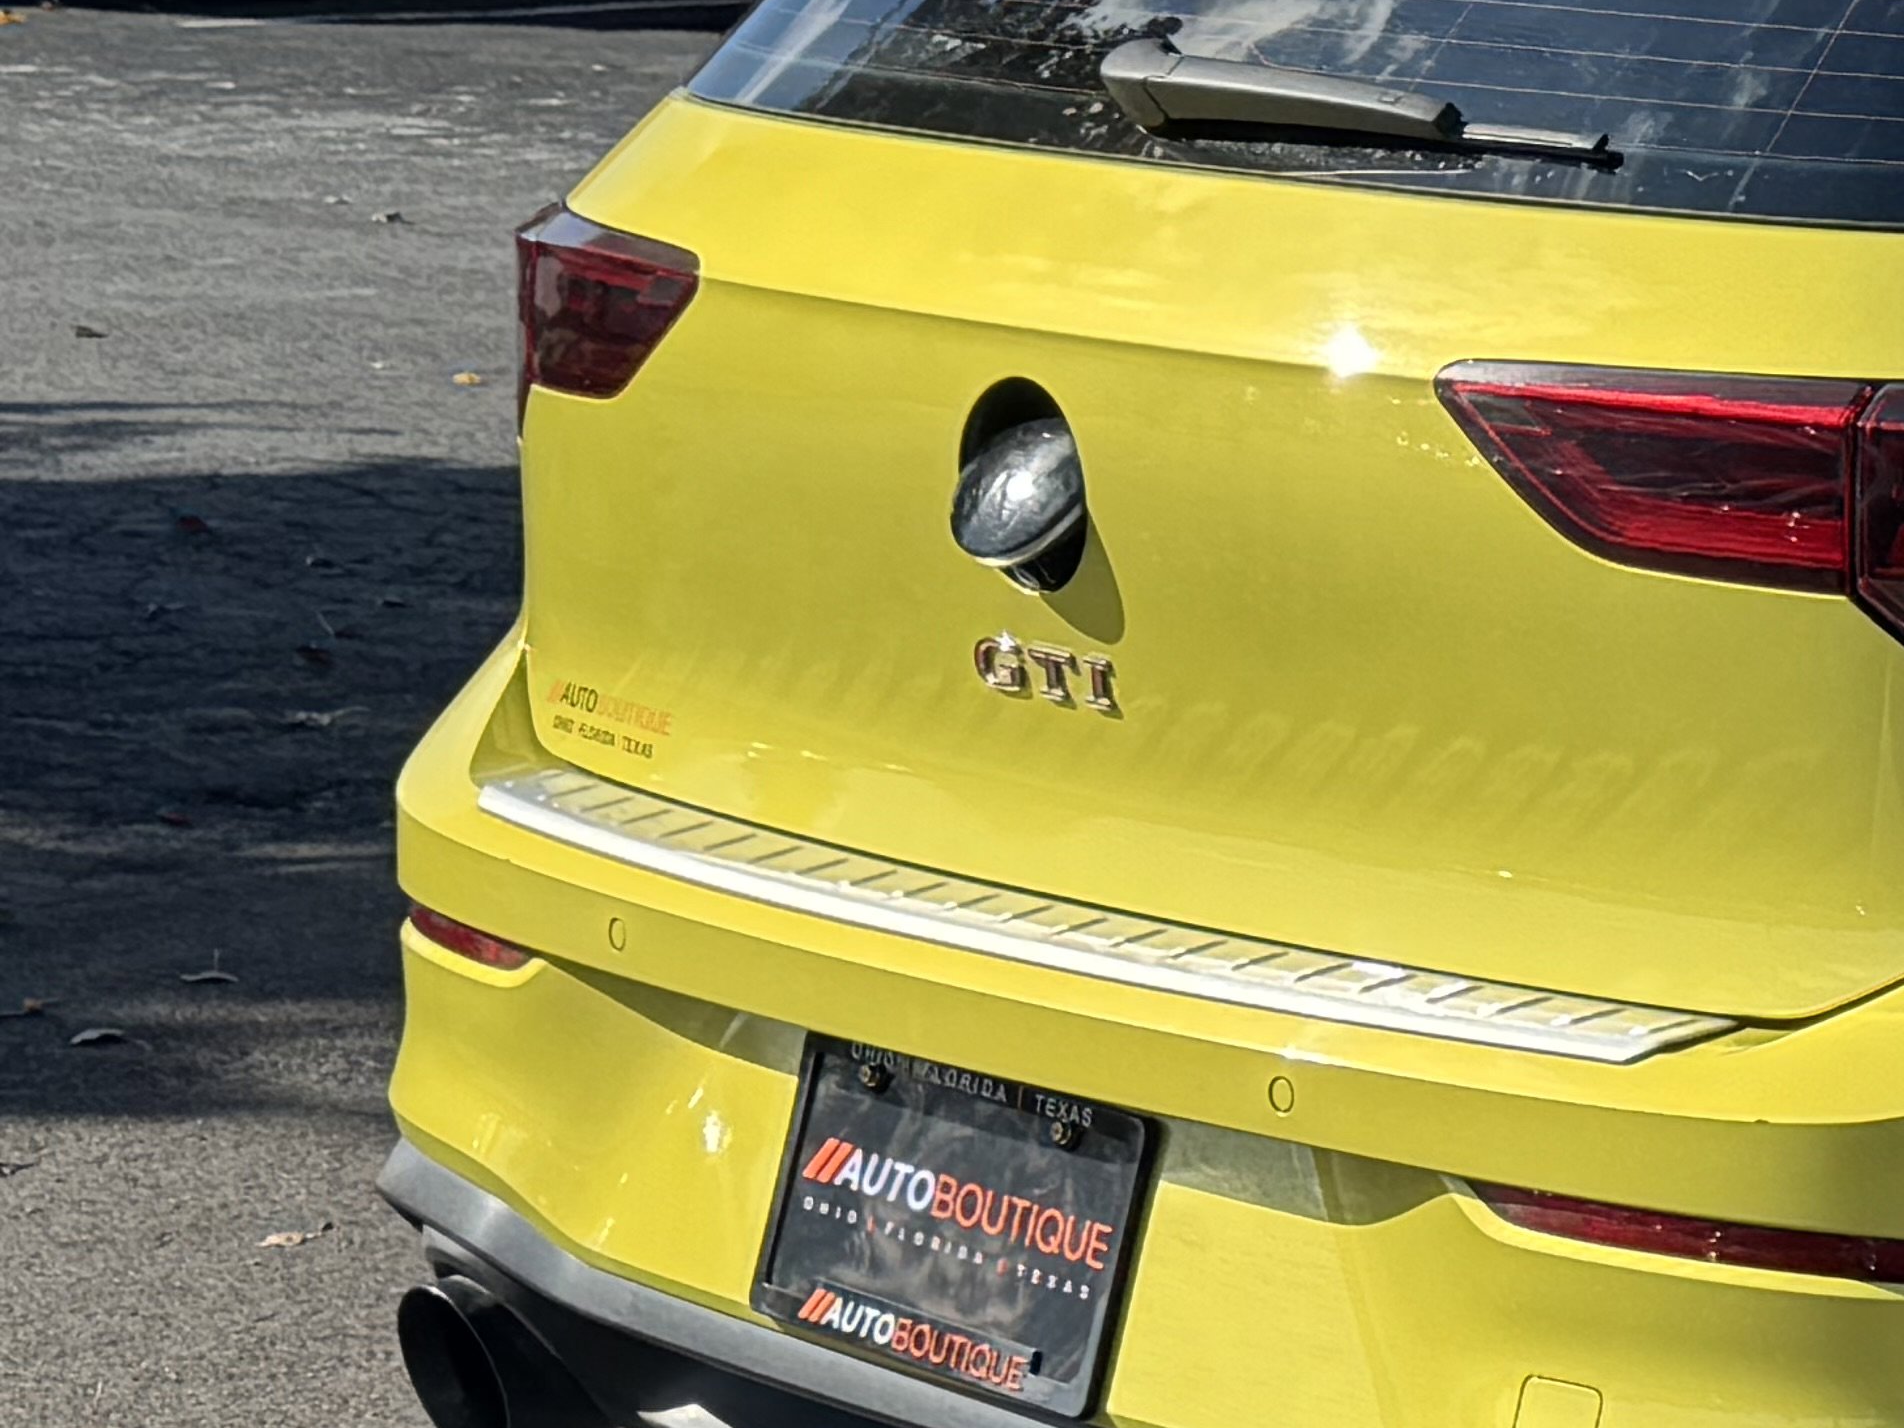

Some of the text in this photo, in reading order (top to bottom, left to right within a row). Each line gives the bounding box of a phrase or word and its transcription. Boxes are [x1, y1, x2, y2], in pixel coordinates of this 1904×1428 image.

[973, 632, 1116, 711] GTI
[1035, 1093, 1093, 1128] TEXAS
[803, 1195, 858, 1225] OHIO
[1016, 1263, 1091, 1301] TEXAS
[835, 1148, 1112, 1270] AUTOBOUTIQUE
[820, 1297, 1031, 1391] AUTOBOUTIQUE
